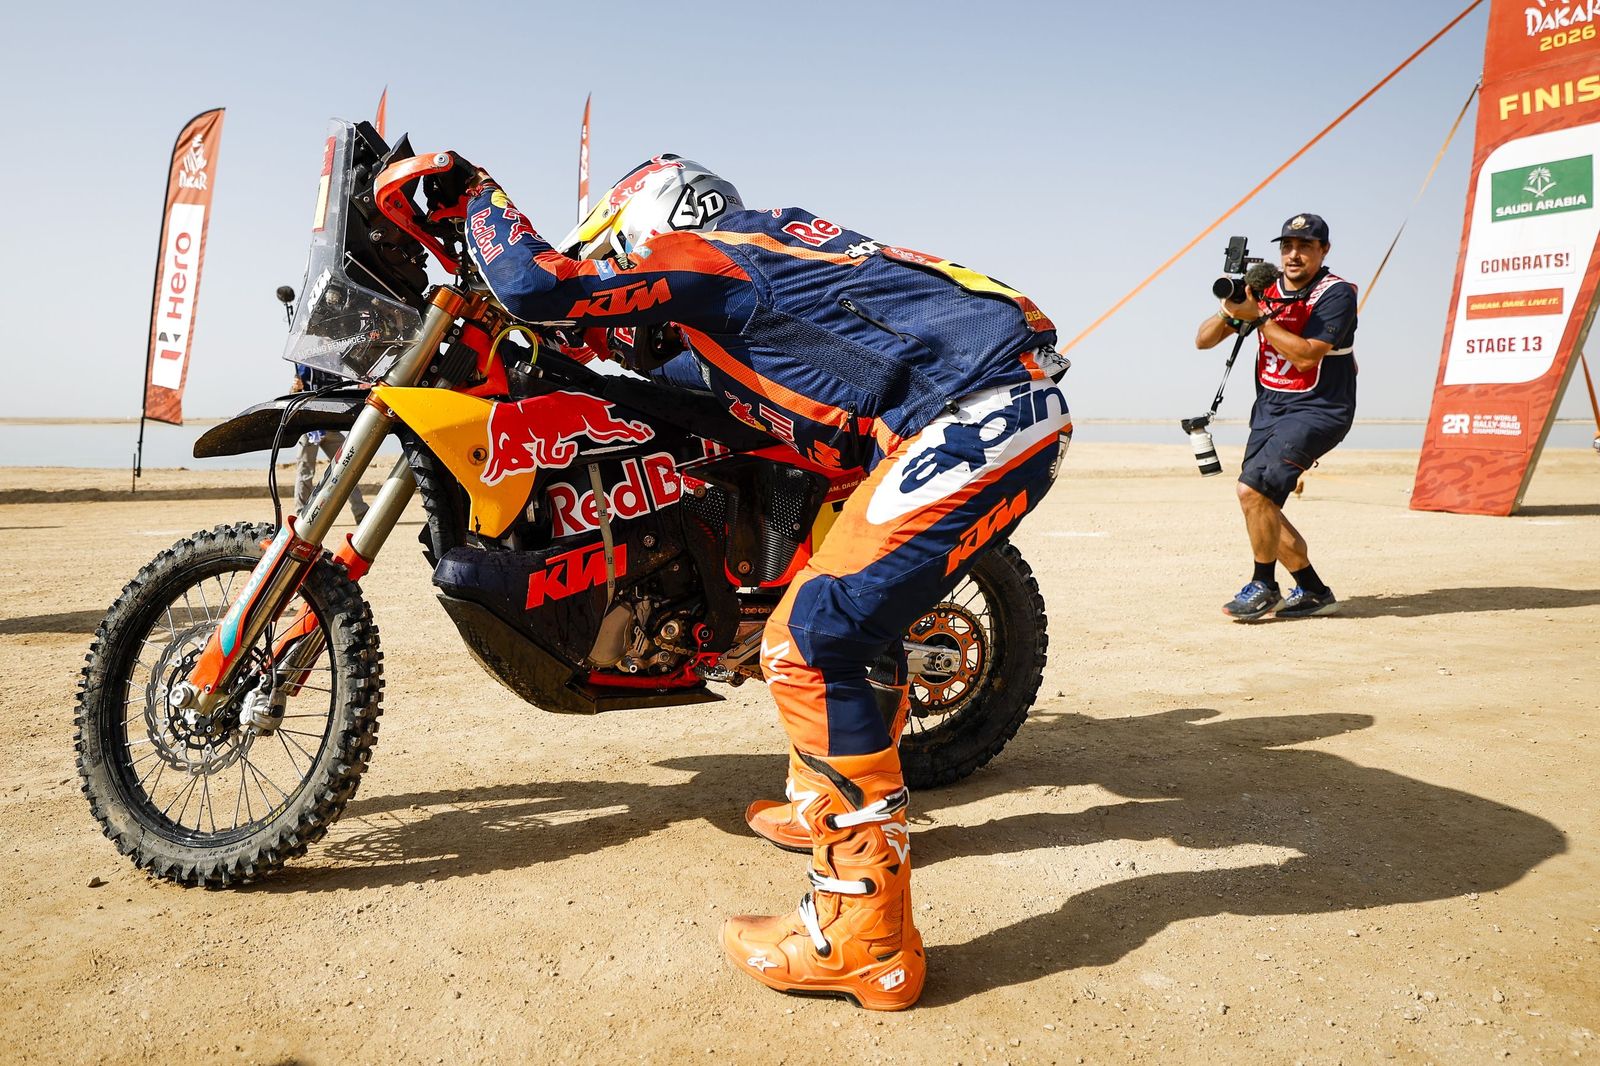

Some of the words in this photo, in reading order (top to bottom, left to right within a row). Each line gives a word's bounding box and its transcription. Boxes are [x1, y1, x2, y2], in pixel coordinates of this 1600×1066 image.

[1540, 24, 1596, 52] 2026
[1495, 203, 1533, 217] SAUDI
[1535, 194, 1587, 211] ARABIA
[166, 231, 192, 320] Hero
[1480, 252, 1570, 274] CONGRATS!
[566, 277, 673, 319] KTM
[1528, 297, 1548, 307] LIVE
[1466, 337, 1517, 354] STAGE
[1522, 336, 1543, 352] 13
[342, 446, 355, 467] SKF
[548, 459, 651, 538] Red
[946, 489, 1028, 577] KTM
[525, 541, 628, 610] KTM
